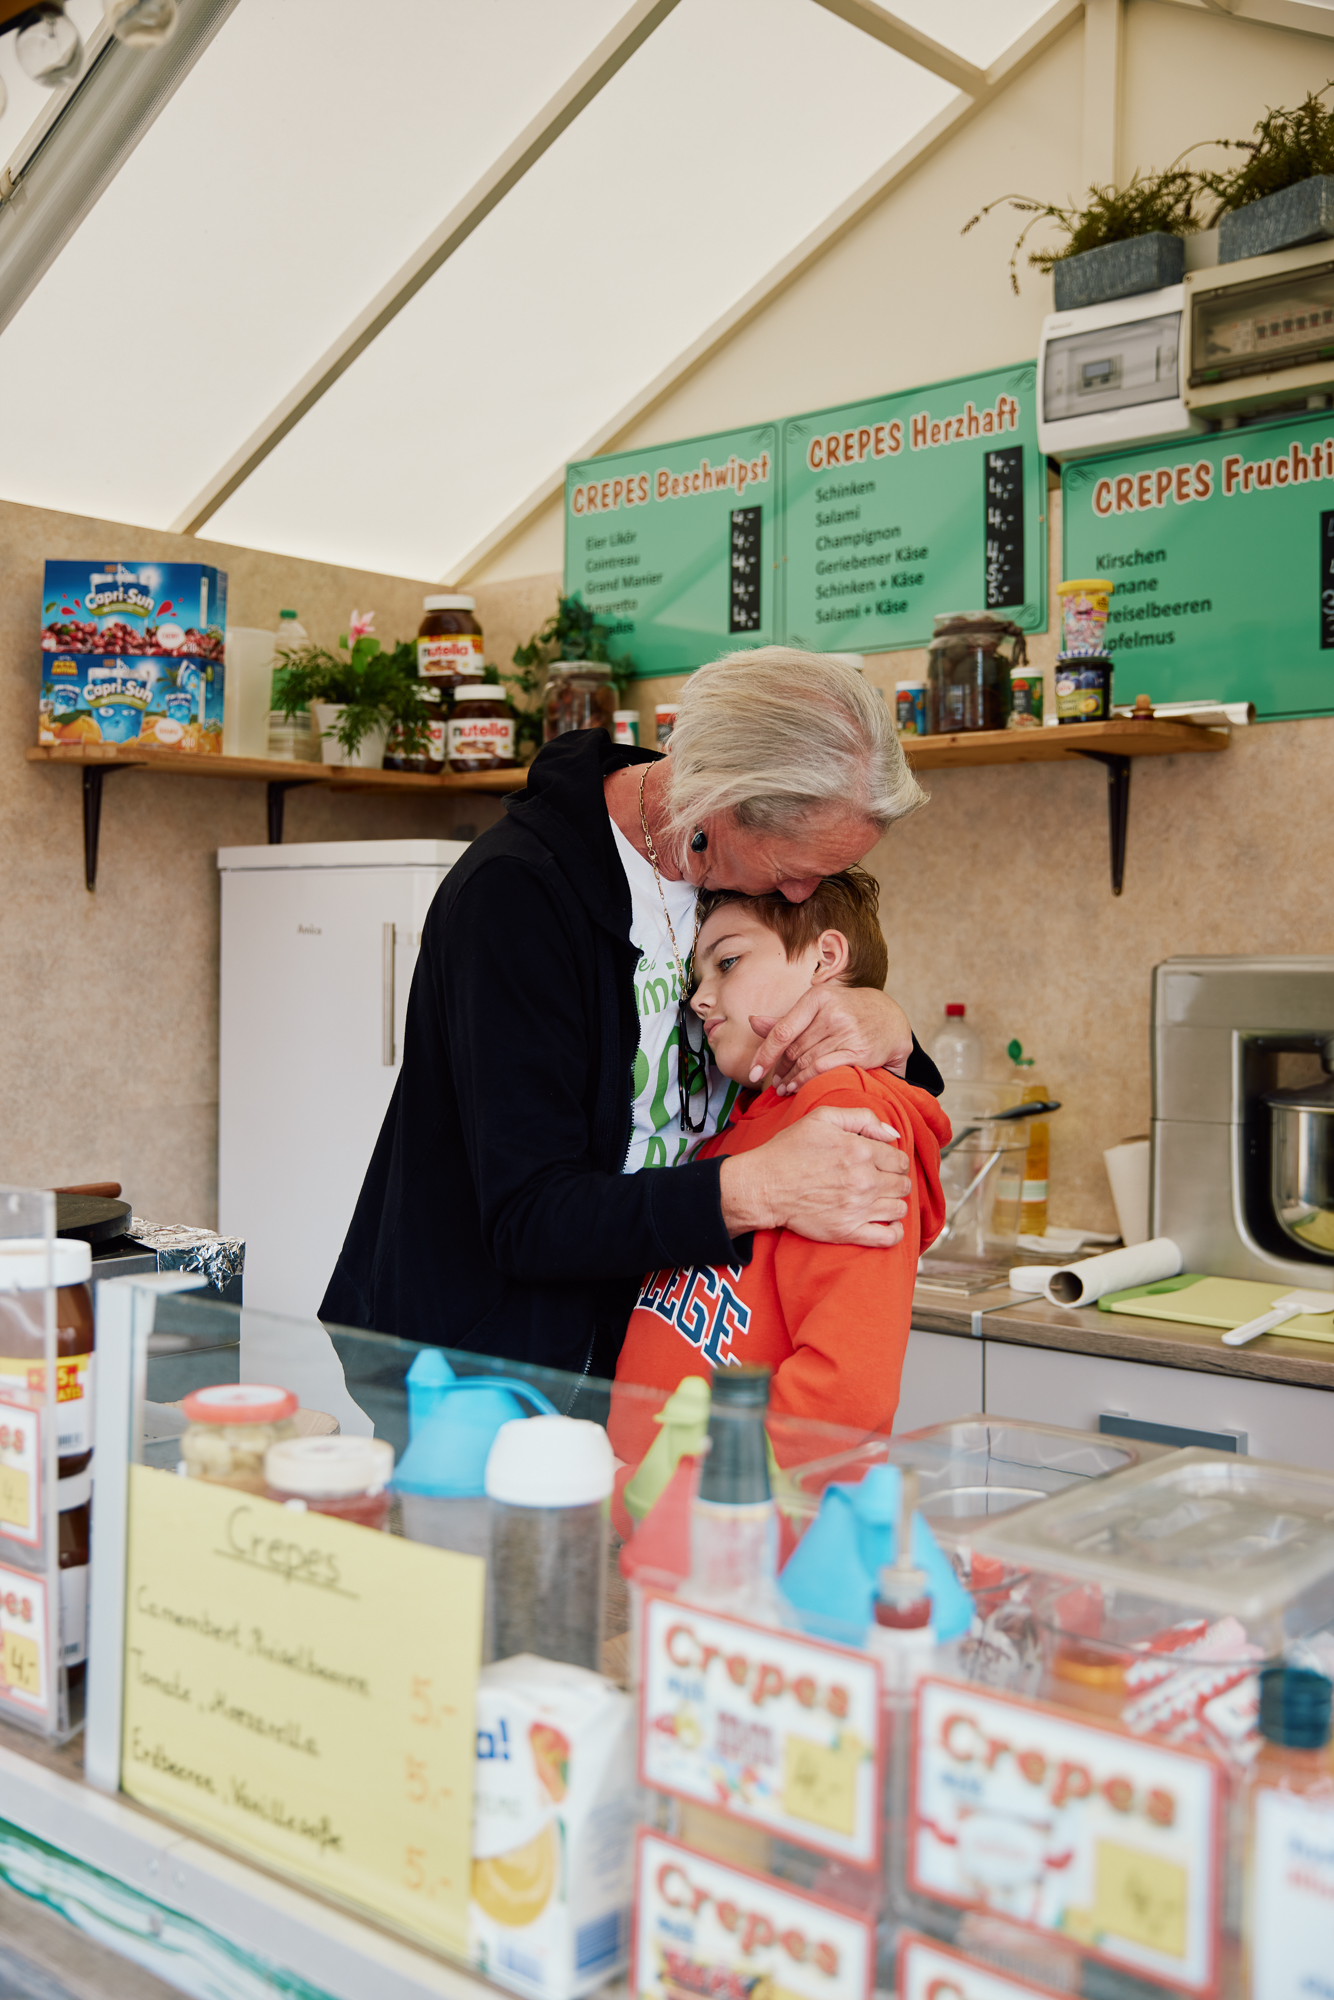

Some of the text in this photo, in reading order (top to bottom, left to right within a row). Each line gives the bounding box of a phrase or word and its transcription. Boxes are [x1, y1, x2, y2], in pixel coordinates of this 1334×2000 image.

[808, 394, 1019, 471] CREPES Herzhaft
[572, 452, 770, 515] CREPES Beschwipst
[815, 480, 875, 503] Schinken
[1093, 462, 1213, 516] CREPES
[815, 505, 861, 527] Salami
[586, 530, 637, 551] Eier Likör
[815, 525, 901, 551] Champignon
[586, 554, 640, 574] Cointreau
[815, 546, 929, 575] Geriebener Käse
[1096, 548, 1167, 572] Kirschen
[586, 571, 663, 595] Grand Manier
[815, 577, 875, 600] Schinken
[891, 572, 925, 589] Käse
[1108, 578, 1160, 597] nane
[85, 586, 155, 611] Capri-Sun
[1106, 598, 1212, 624] reiselbeeren
[815, 602, 861, 624] Salami
[875, 600, 909, 617] Käse
[422, 643, 469, 658] nutella
[83, 679, 153, 704] Capri-Sun
[453, 722, 509, 738] nutella
[227, 1505, 341, 1587] Crepes
[664, 1620, 851, 1719] Crepes
[940, 1712, 1177, 1828] Crepes
[655, 1860, 840, 1977] Crepes
